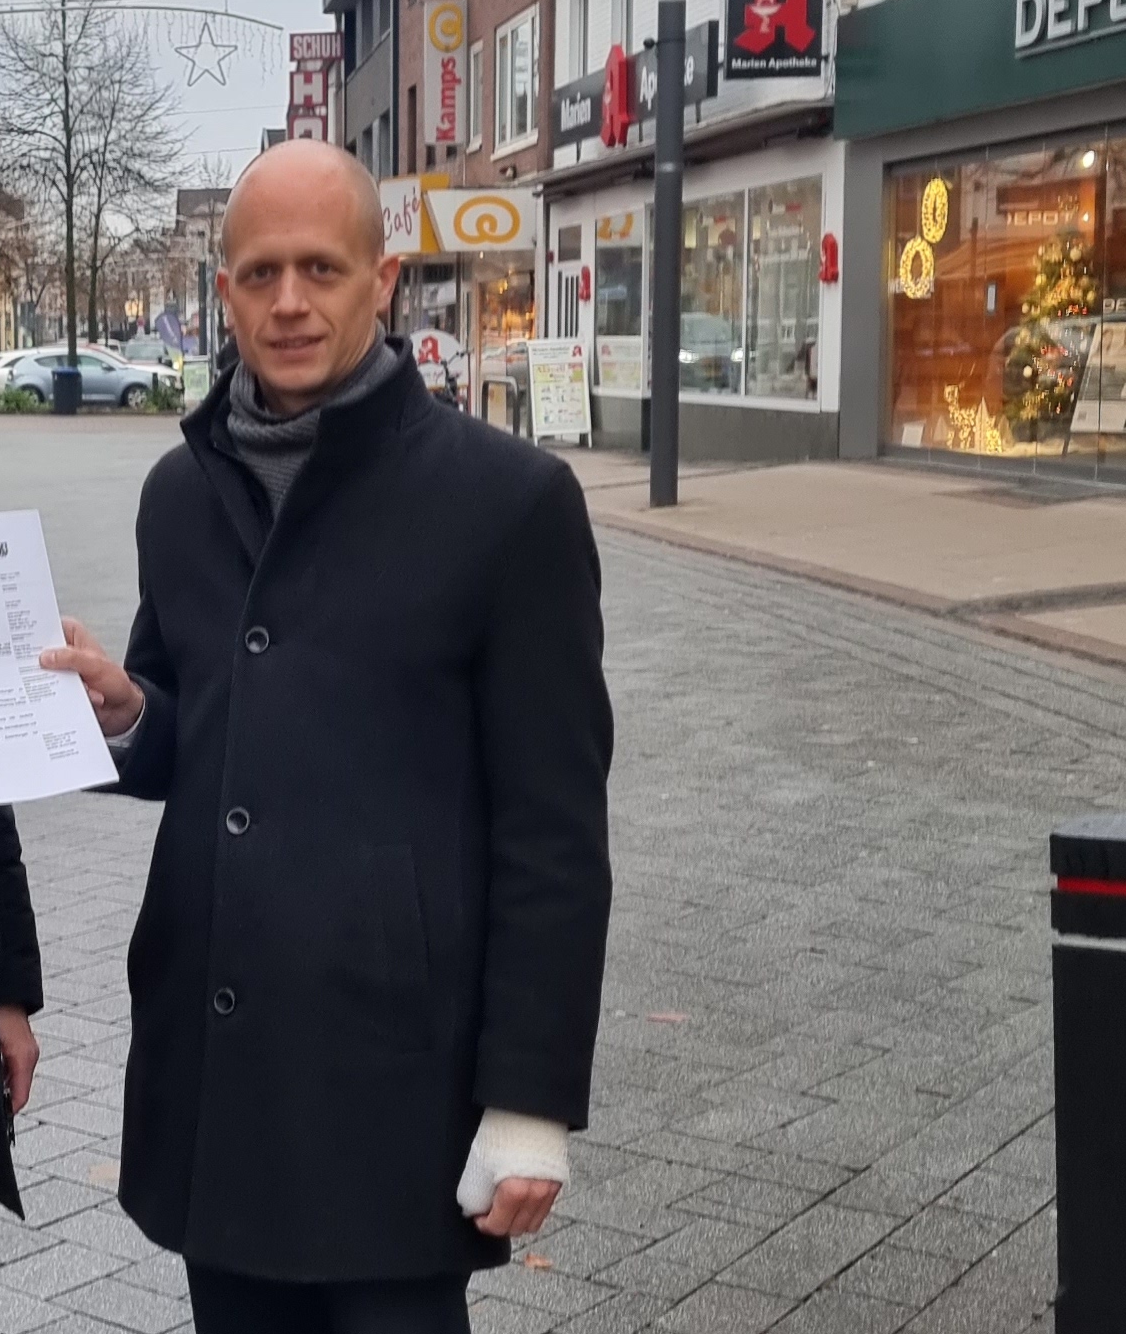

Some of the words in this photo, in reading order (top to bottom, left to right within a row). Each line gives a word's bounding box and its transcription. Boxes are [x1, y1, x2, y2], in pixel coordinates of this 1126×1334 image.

[292, 34, 341, 60] SCHUH
[731, 58, 767, 69] Marien
[768, 56, 817, 71] Apotheke
[435, 55, 462, 143] Kamps
[560, 91, 591, 132] Marien
[383, 185, 421, 241] Café
